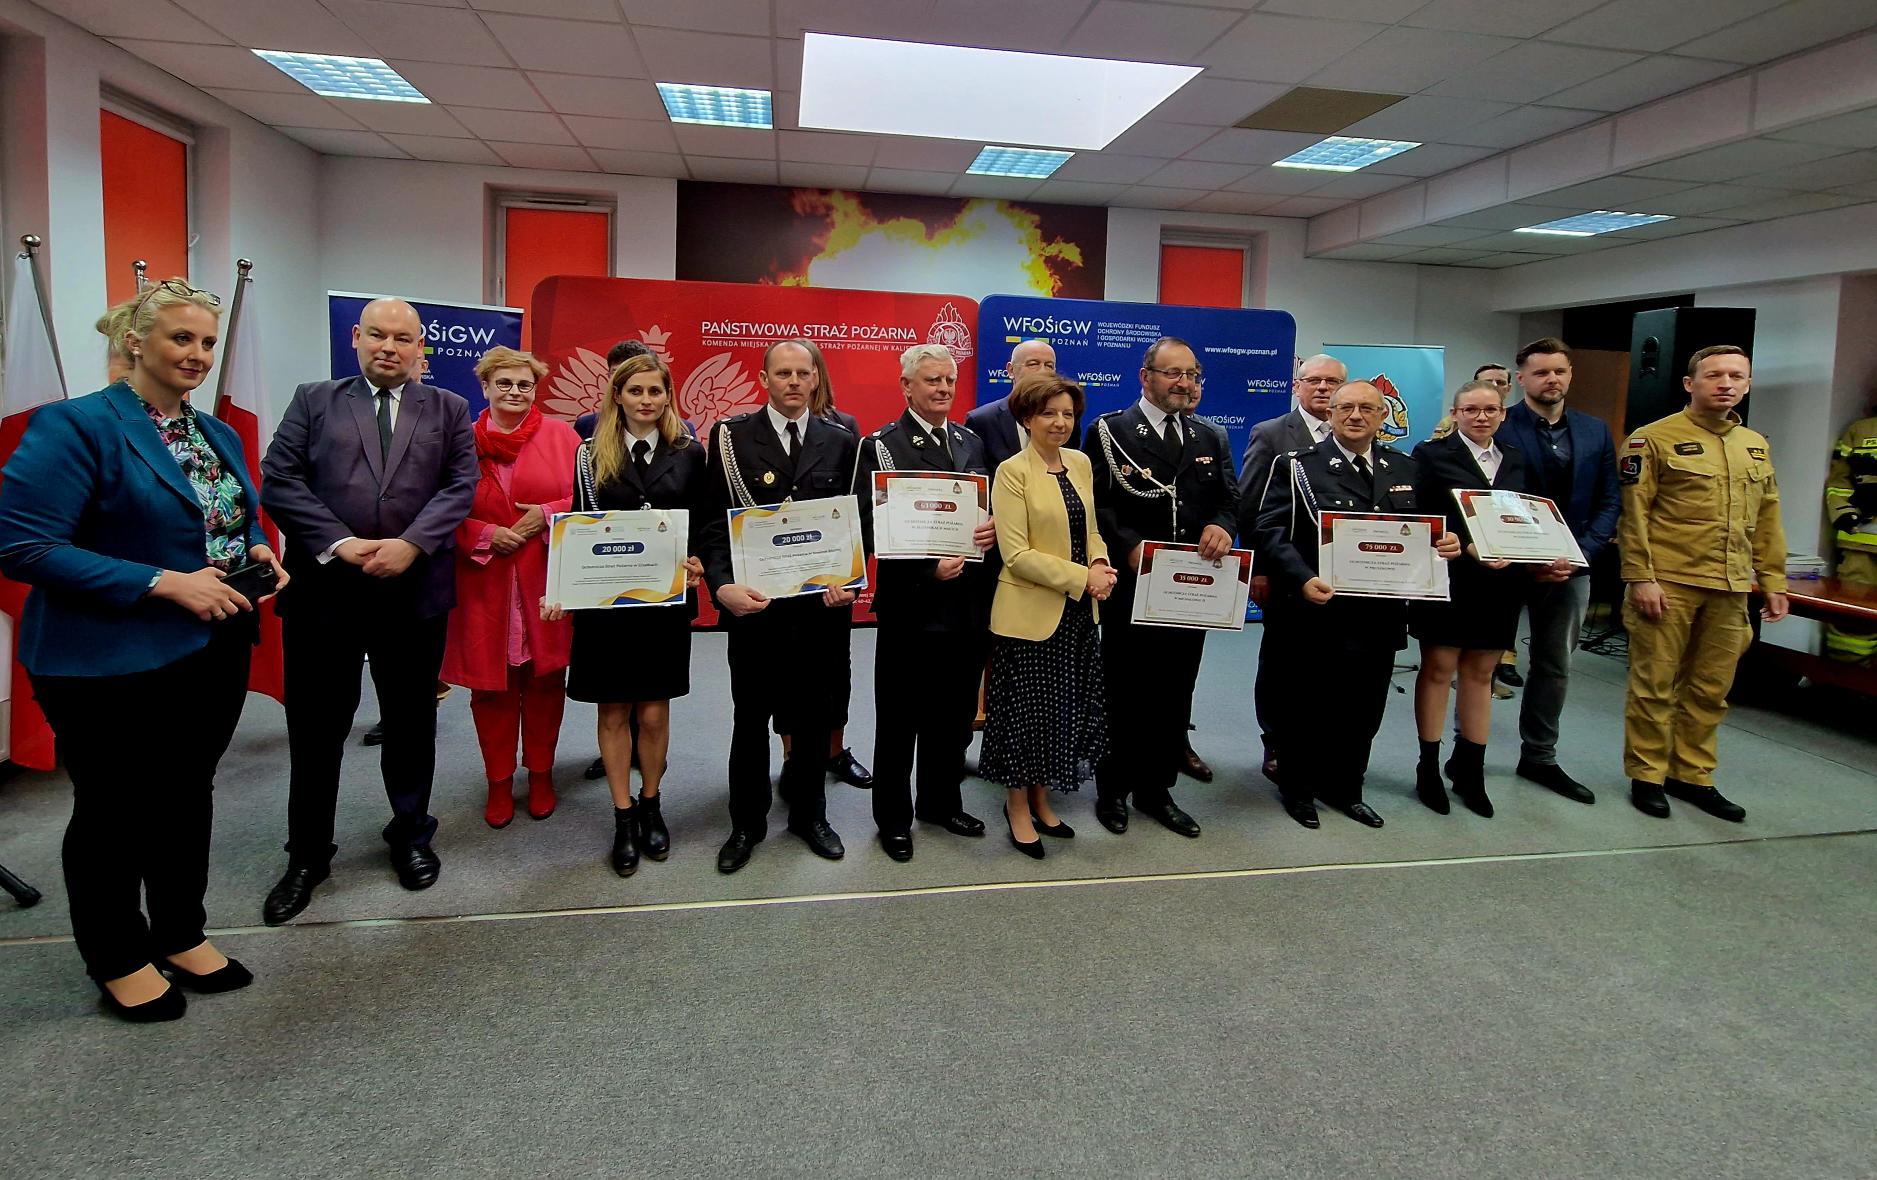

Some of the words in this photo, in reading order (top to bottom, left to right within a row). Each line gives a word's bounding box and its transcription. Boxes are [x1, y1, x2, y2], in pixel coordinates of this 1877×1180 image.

[701, 319, 800, 336] PAŃSTWOWA
[803, 323, 848, 338] STRAŻ
[851, 324, 917, 340] POŻARNA
[1003, 316, 1092, 335] WFOŚiGW
[820, 342, 845, 350] STRAŻY
[847, 343, 880, 352] POŻARNEJ
[1051, 338, 1089, 346] POZNAŃ
[437, 347, 486, 358] POZNA
[1204, 346, 1278, 356] www.wfosgw.poznan.pl
[792, 534, 805, 542] 000
[602, 545, 612, 553] 20
